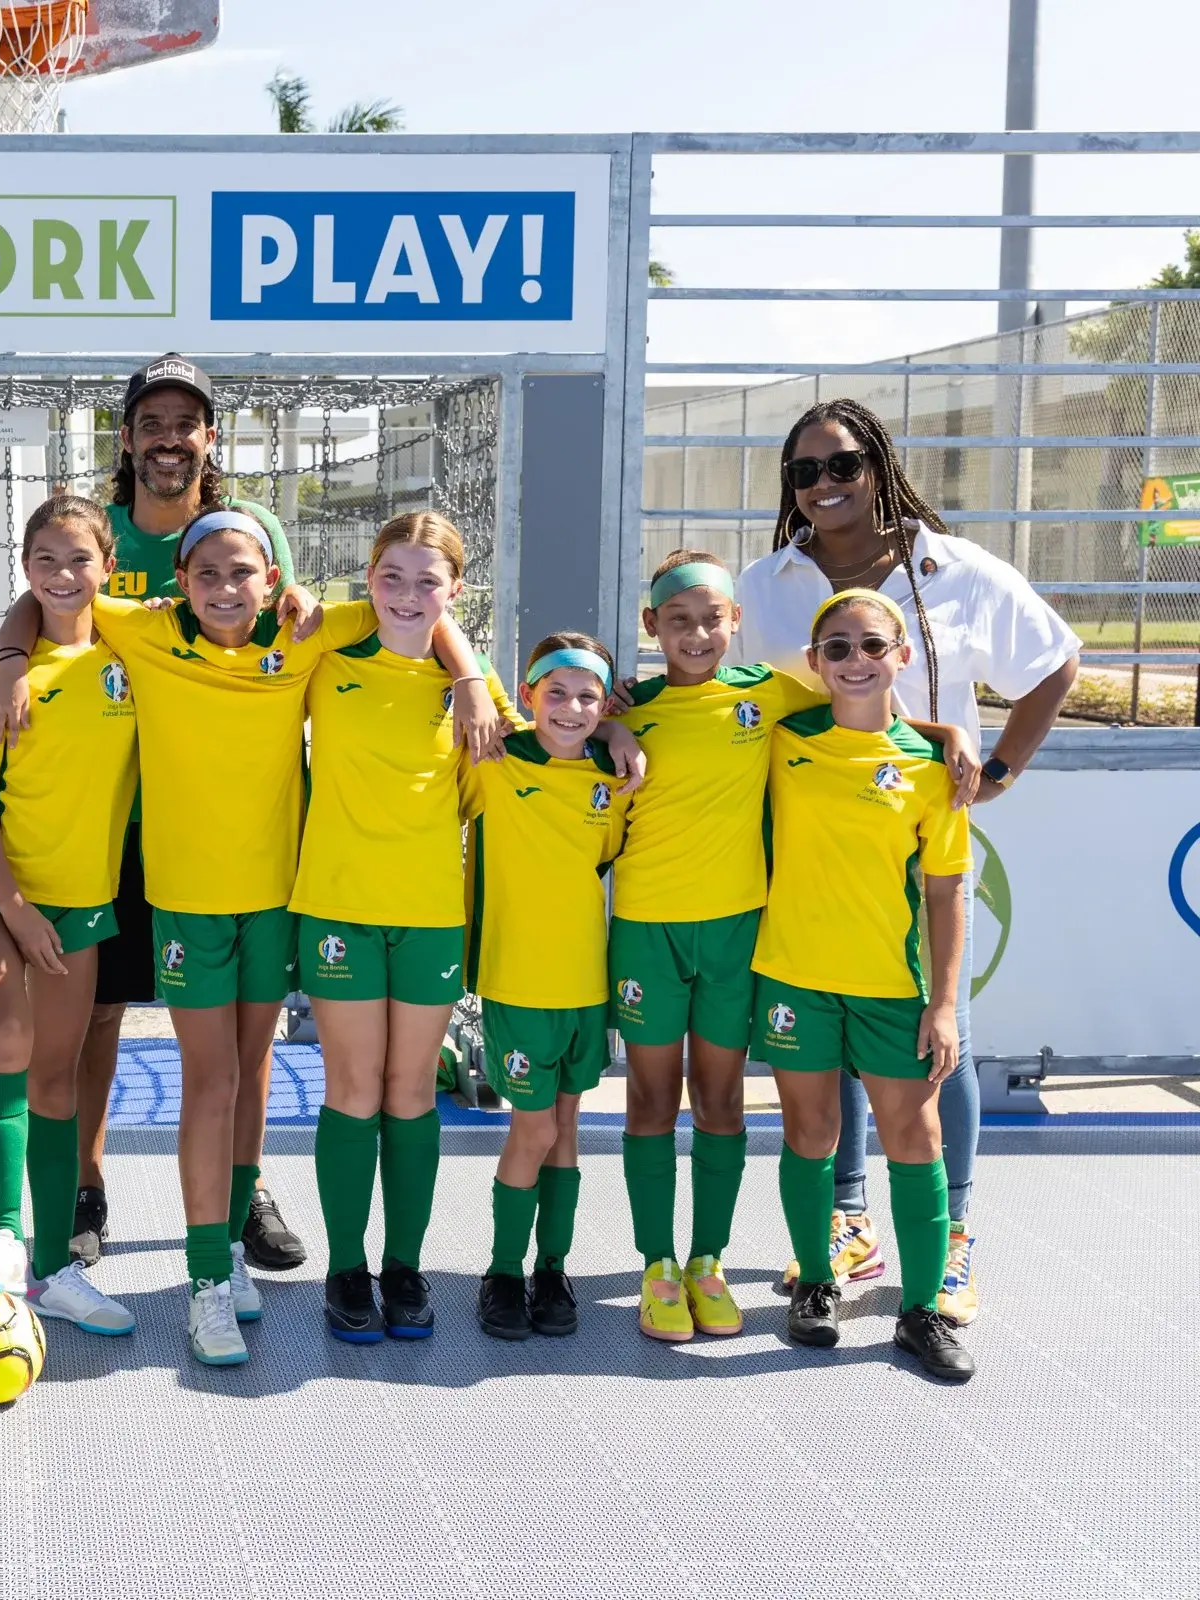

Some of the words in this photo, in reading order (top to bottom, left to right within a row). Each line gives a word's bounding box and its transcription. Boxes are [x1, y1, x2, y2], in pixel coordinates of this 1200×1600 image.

[241, 214, 545, 304] PLAY!
[168, 970, 184, 978] Bonito
[167, 979, 186, 988] Academy
[777, 1033, 797, 1042] Bonito
[776, 1043, 800, 1051] Academy
